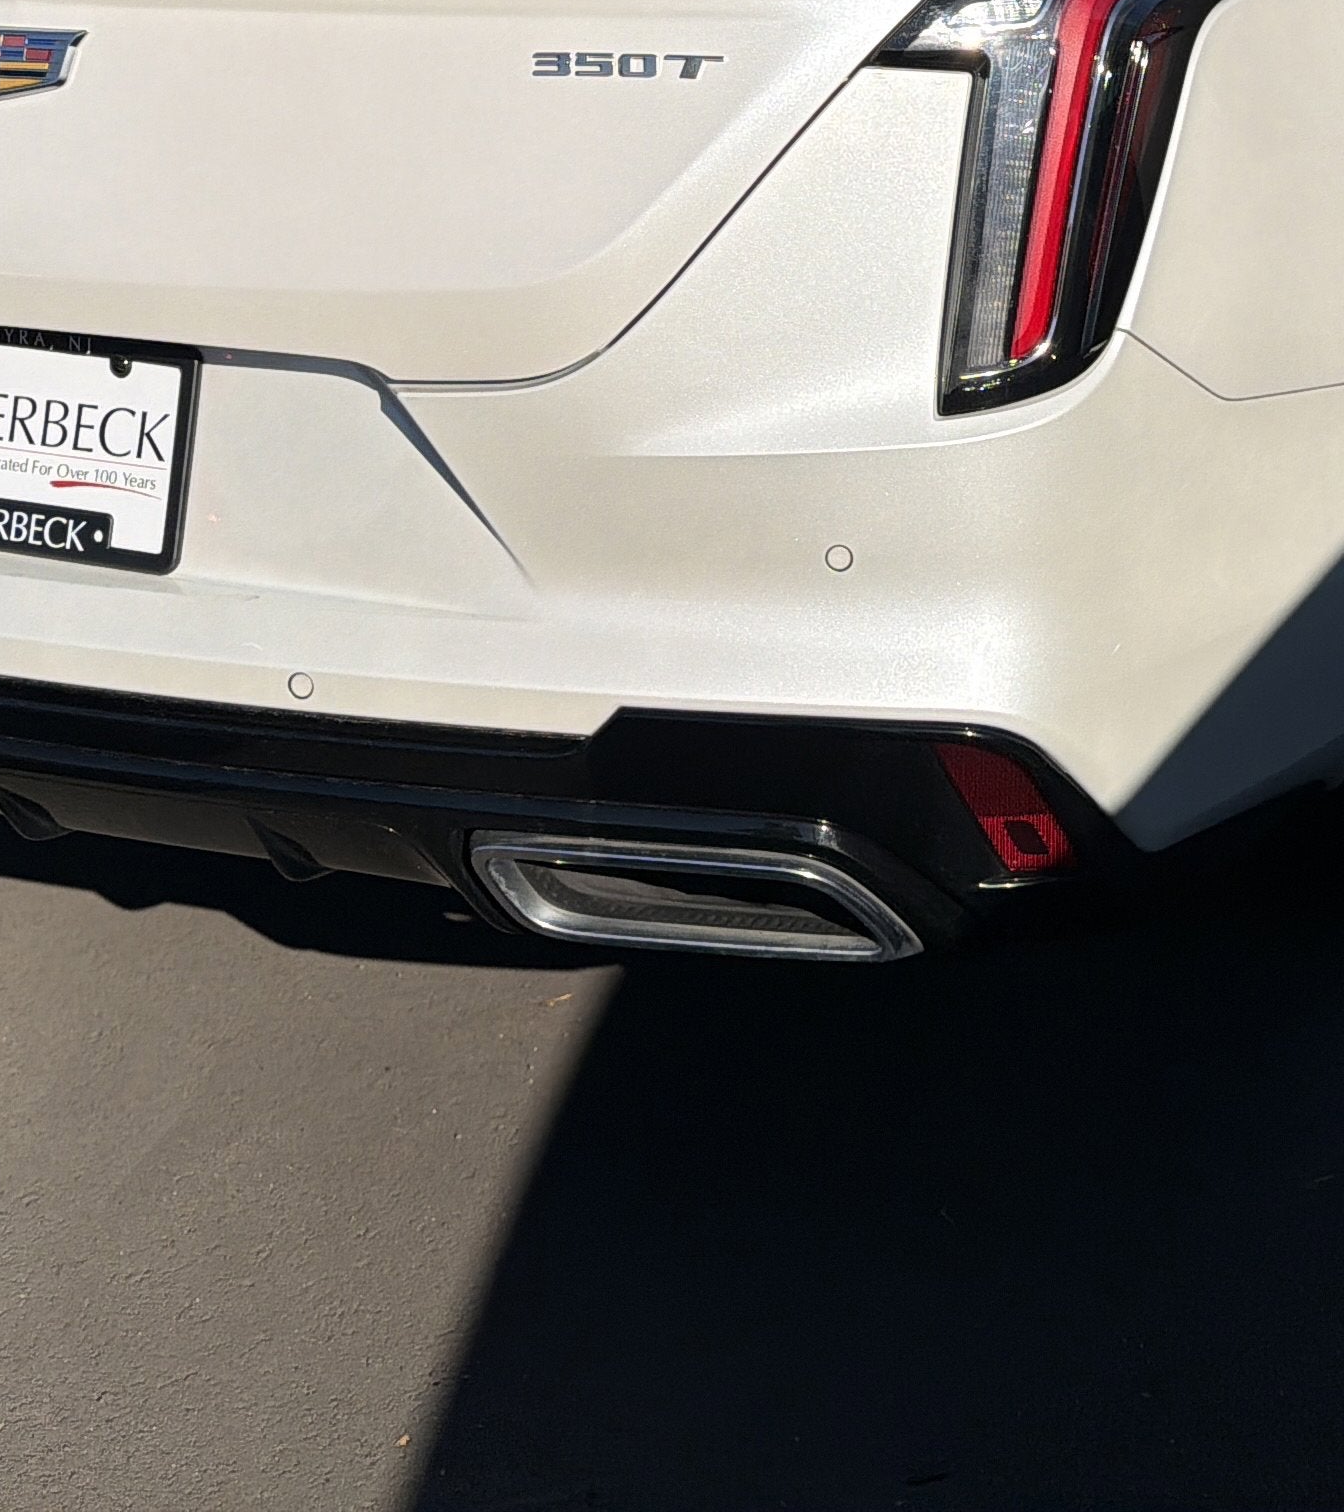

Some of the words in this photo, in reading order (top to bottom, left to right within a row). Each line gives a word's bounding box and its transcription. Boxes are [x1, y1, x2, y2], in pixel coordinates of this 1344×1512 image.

[532, 52, 725, 80] 350T
[68, 334, 92, 356] NJ
[31, 460, 53, 476] For
[56, 463, 89, 481] Over
[94, 469, 118, 485] 100
[123, 472, 156, 491] Years
